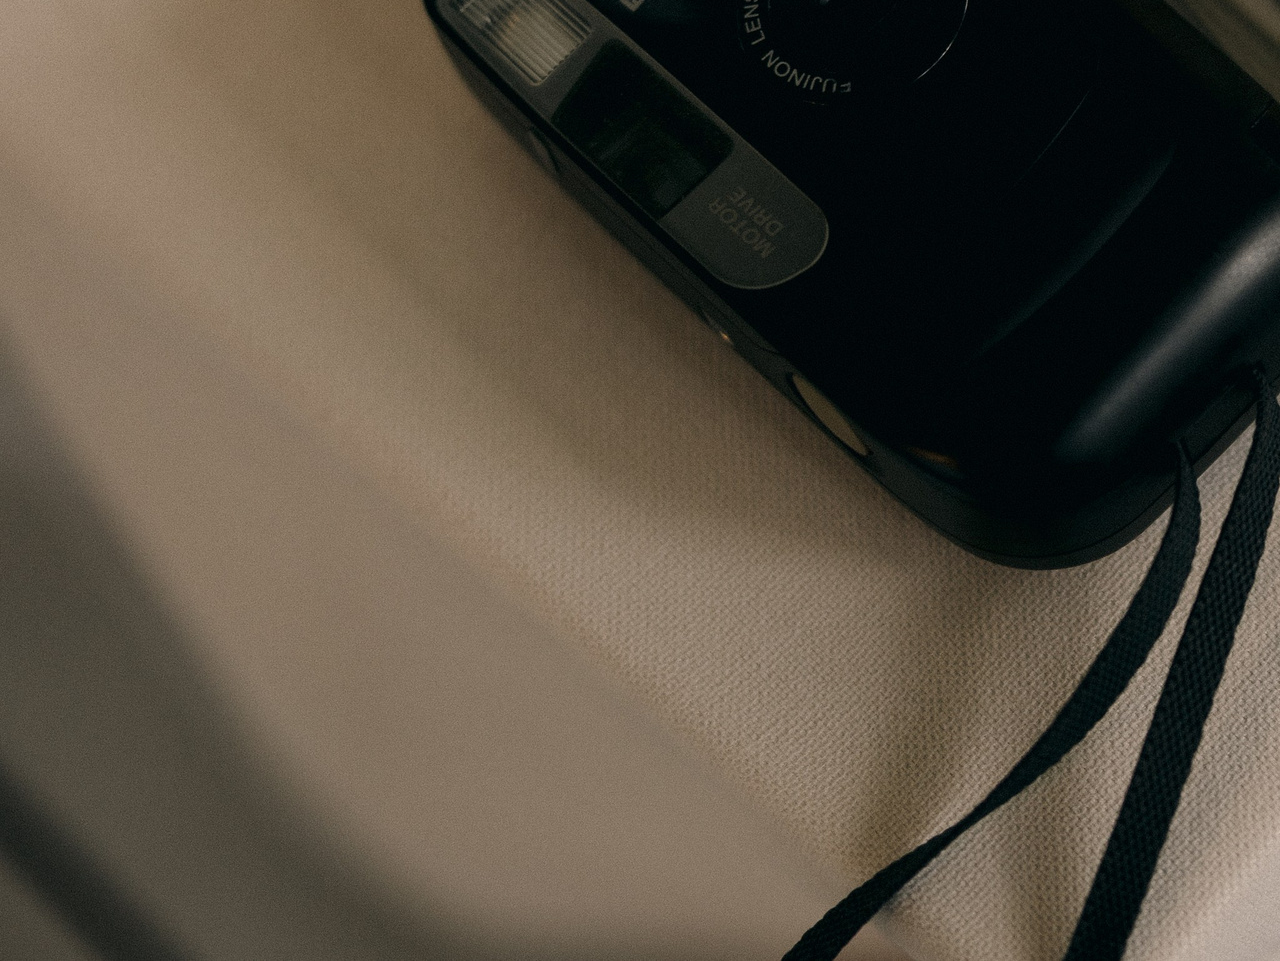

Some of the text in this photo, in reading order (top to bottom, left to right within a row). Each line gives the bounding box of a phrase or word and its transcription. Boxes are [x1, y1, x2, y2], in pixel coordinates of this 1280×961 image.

[761, 49, 851, 93] FUJINON
[708, 197, 777, 258] MOTOR
[728, 188, 784, 236] DRIVE
